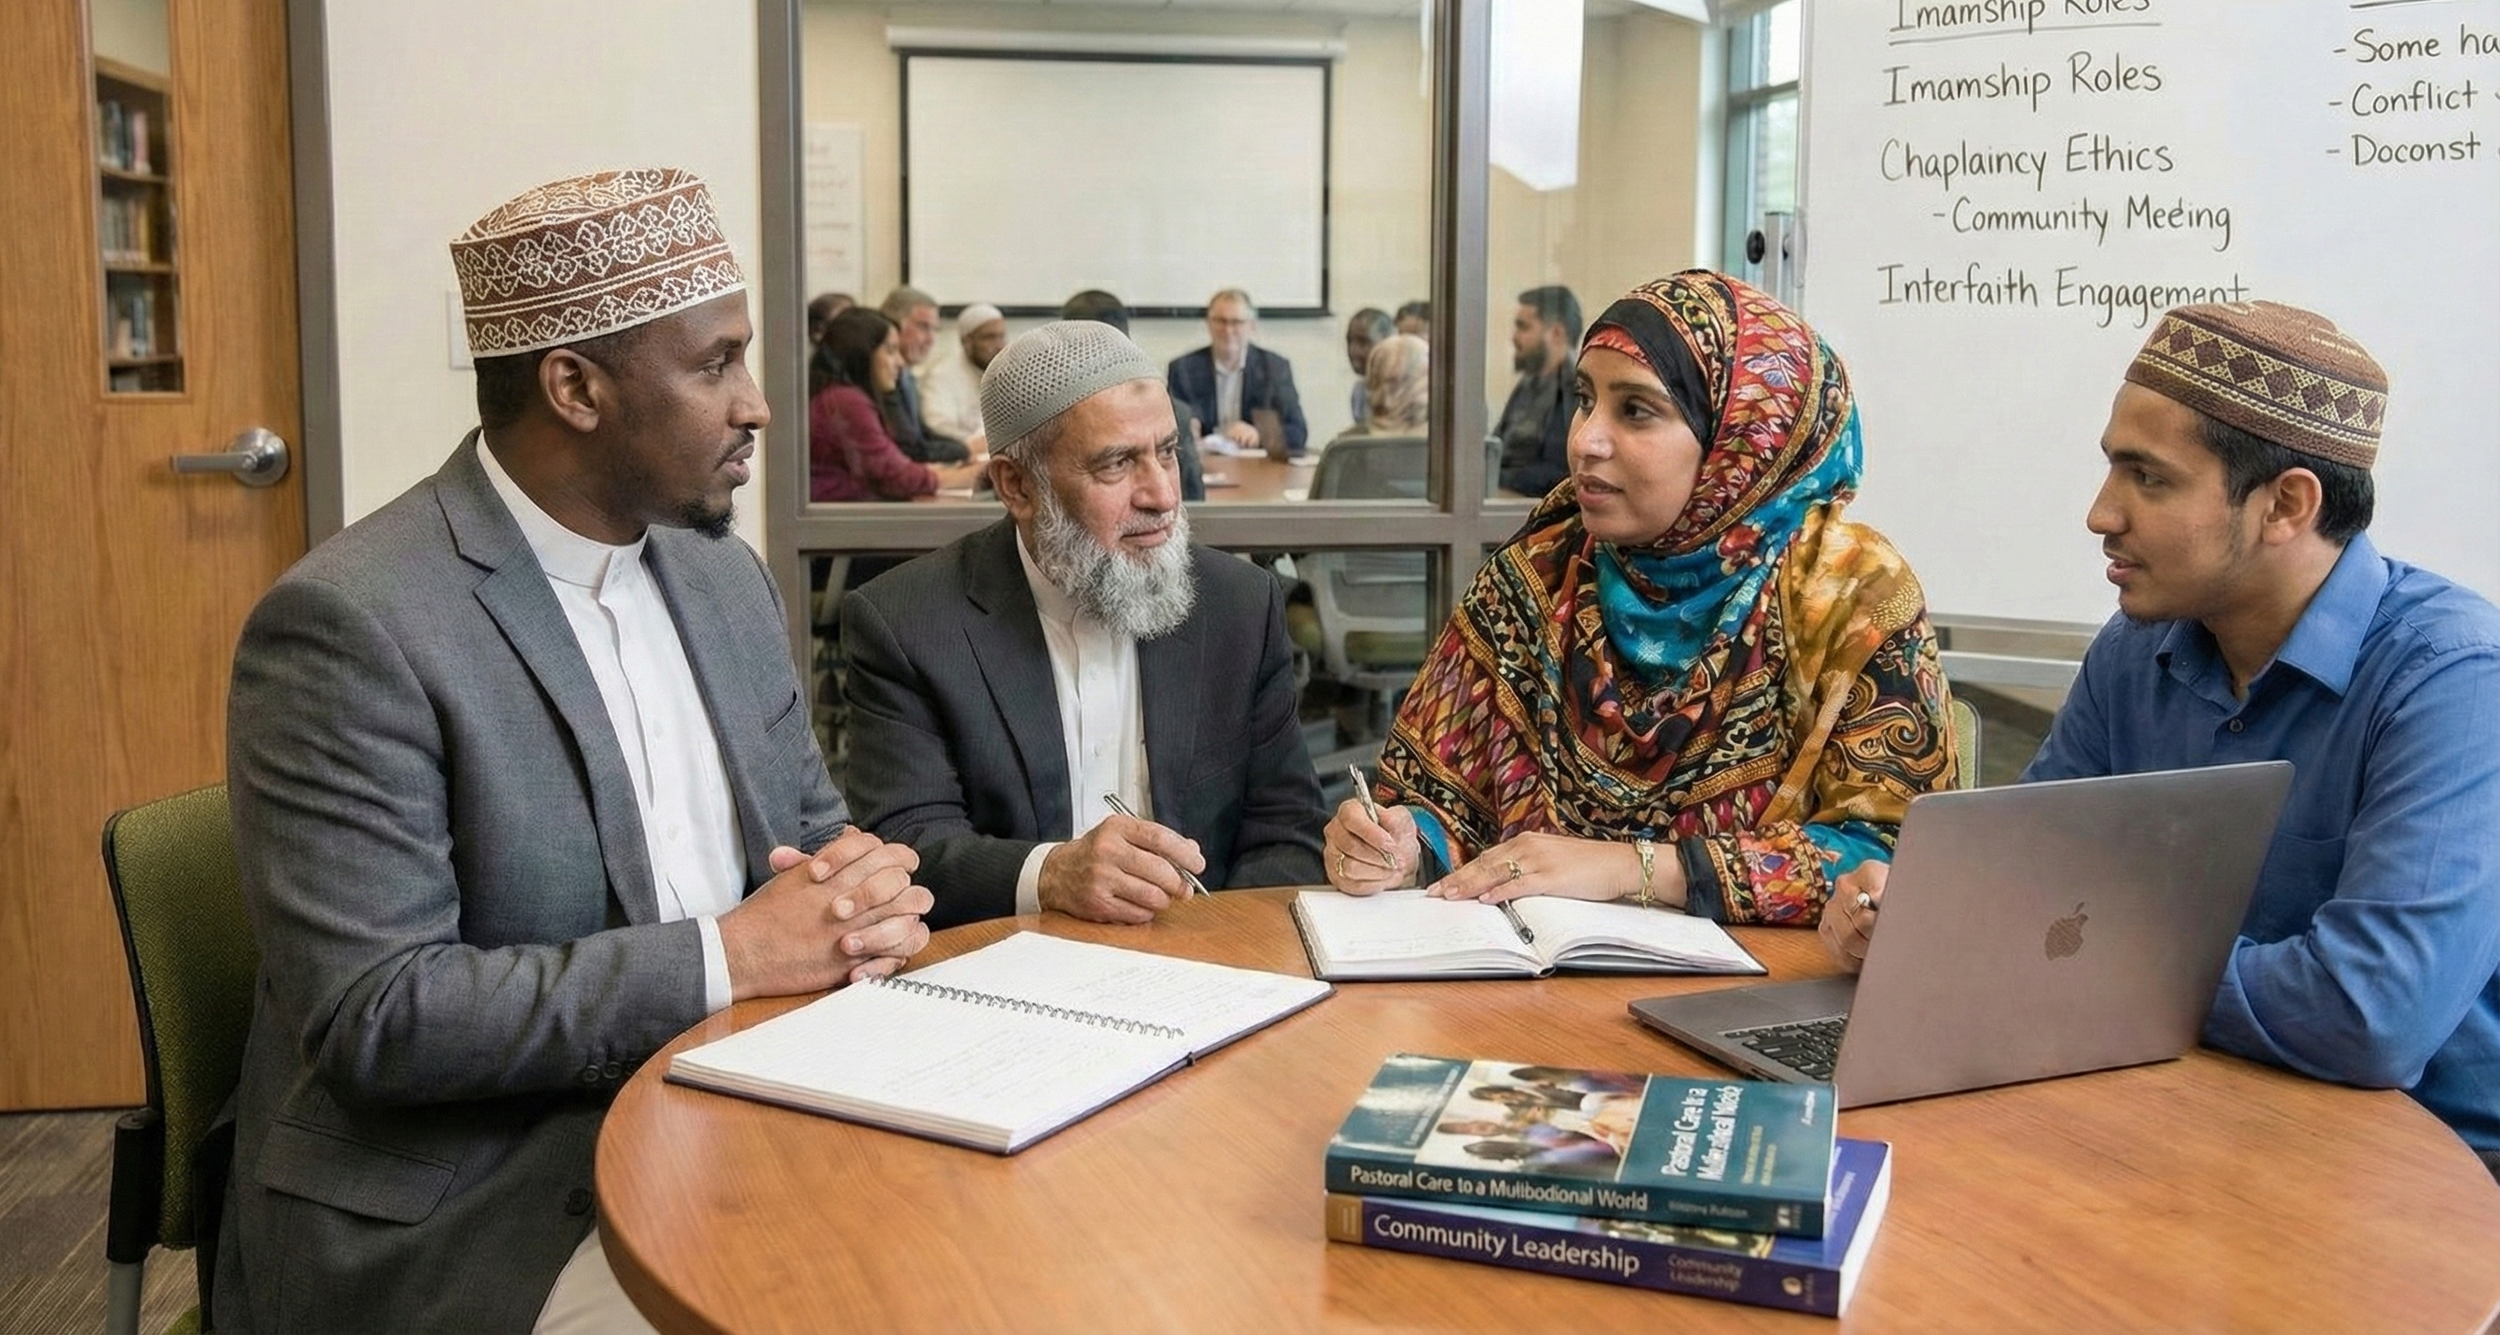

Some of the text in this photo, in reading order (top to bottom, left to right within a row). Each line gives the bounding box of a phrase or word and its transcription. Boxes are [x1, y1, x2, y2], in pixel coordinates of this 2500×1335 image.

[1882, 50, 2163, 113] Imamship Roles
[1881, 133, 2174, 192] Chaplaincy Ethics
[1877, 262, 2250, 329] Interfaith Engagement
[1351, 1165, 1413, 1188] Pastoral
[1416, 1168, 1453, 1192] Care
[1458, 1176, 1472, 1194] to
[1475, 1181, 1486, 1196] a
[1598, 1190, 1648, 1212] World
[1374, 1214, 1640, 1277] Community Leadership
